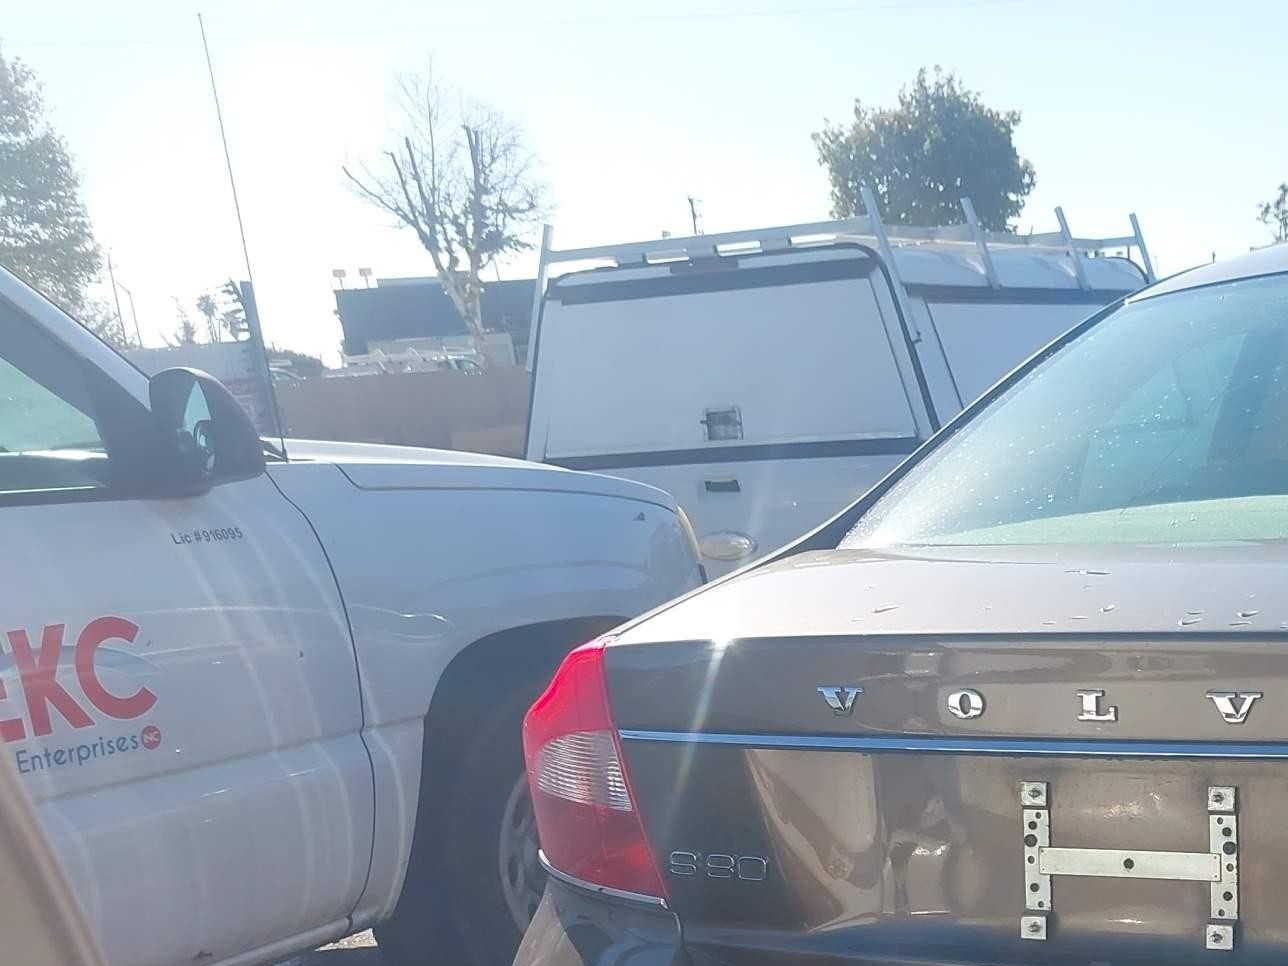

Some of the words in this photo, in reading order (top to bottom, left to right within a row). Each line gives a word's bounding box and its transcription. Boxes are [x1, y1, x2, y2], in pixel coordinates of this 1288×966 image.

[170, 531, 192, 545] Lic
[193, 526, 243, 543] #916095
[15, 734, 140, 775] Enterprises
[669, 850, 768, 881] S80
